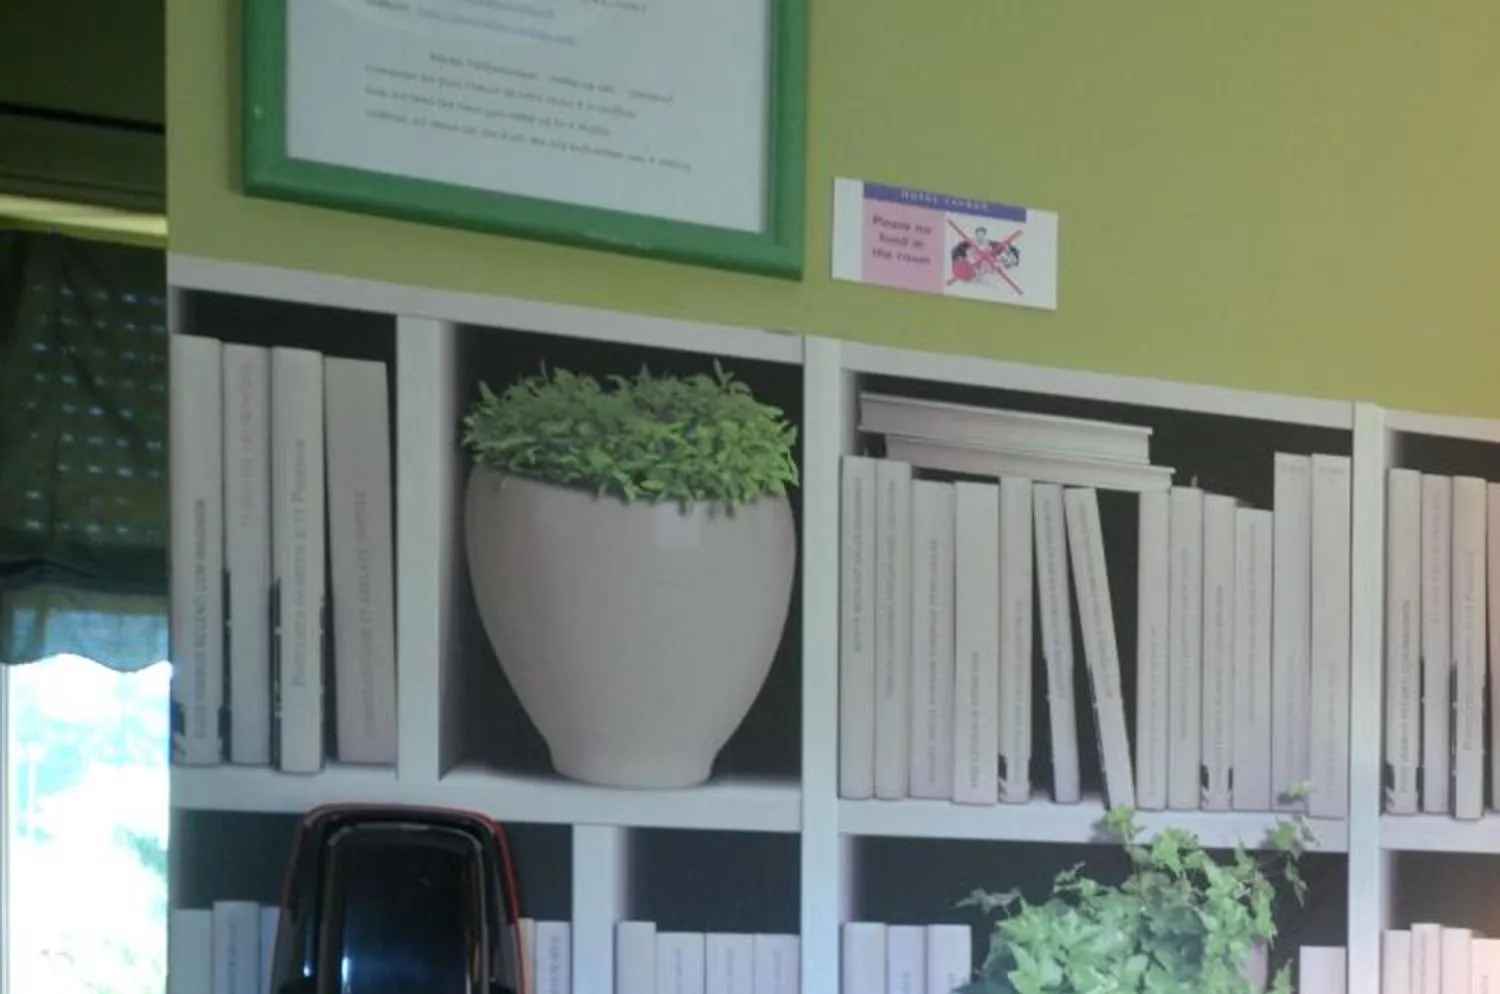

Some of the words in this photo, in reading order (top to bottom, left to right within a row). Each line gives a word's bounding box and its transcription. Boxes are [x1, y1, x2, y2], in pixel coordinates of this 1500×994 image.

[873, 215, 911, 231] Please
[915, 224, 932, 235] no
[880, 232, 909, 247] food
[872, 247, 891, 259] the
[898, 252, 930, 265] room
